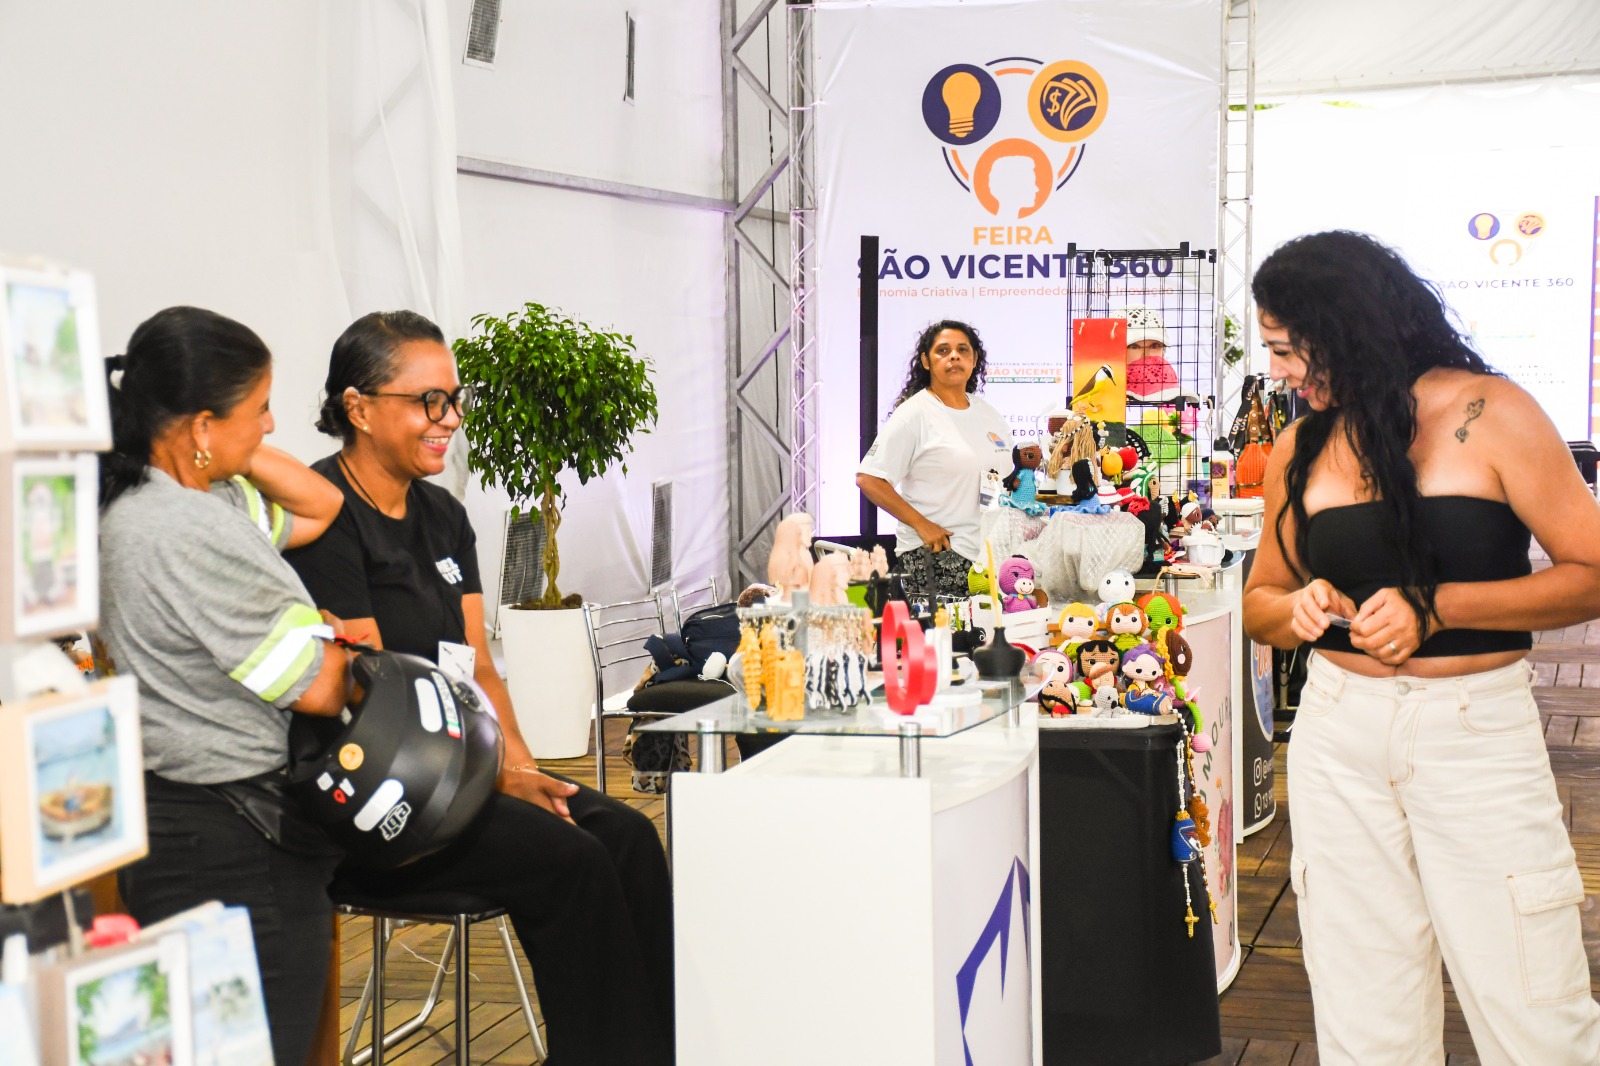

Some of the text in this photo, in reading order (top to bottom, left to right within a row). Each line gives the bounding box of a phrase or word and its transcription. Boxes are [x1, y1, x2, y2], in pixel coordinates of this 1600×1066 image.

[973, 226, 1053, 246] FEIRA
[857, 248, 1174, 280] ÃO VICENTE 360
[1475, 278, 1540, 289] VICENTE
[1546, 277, 1574, 288] 360
[921, 286, 968, 298] Criativa
[987, 366, 1063, 376] SÃO VICENTE
